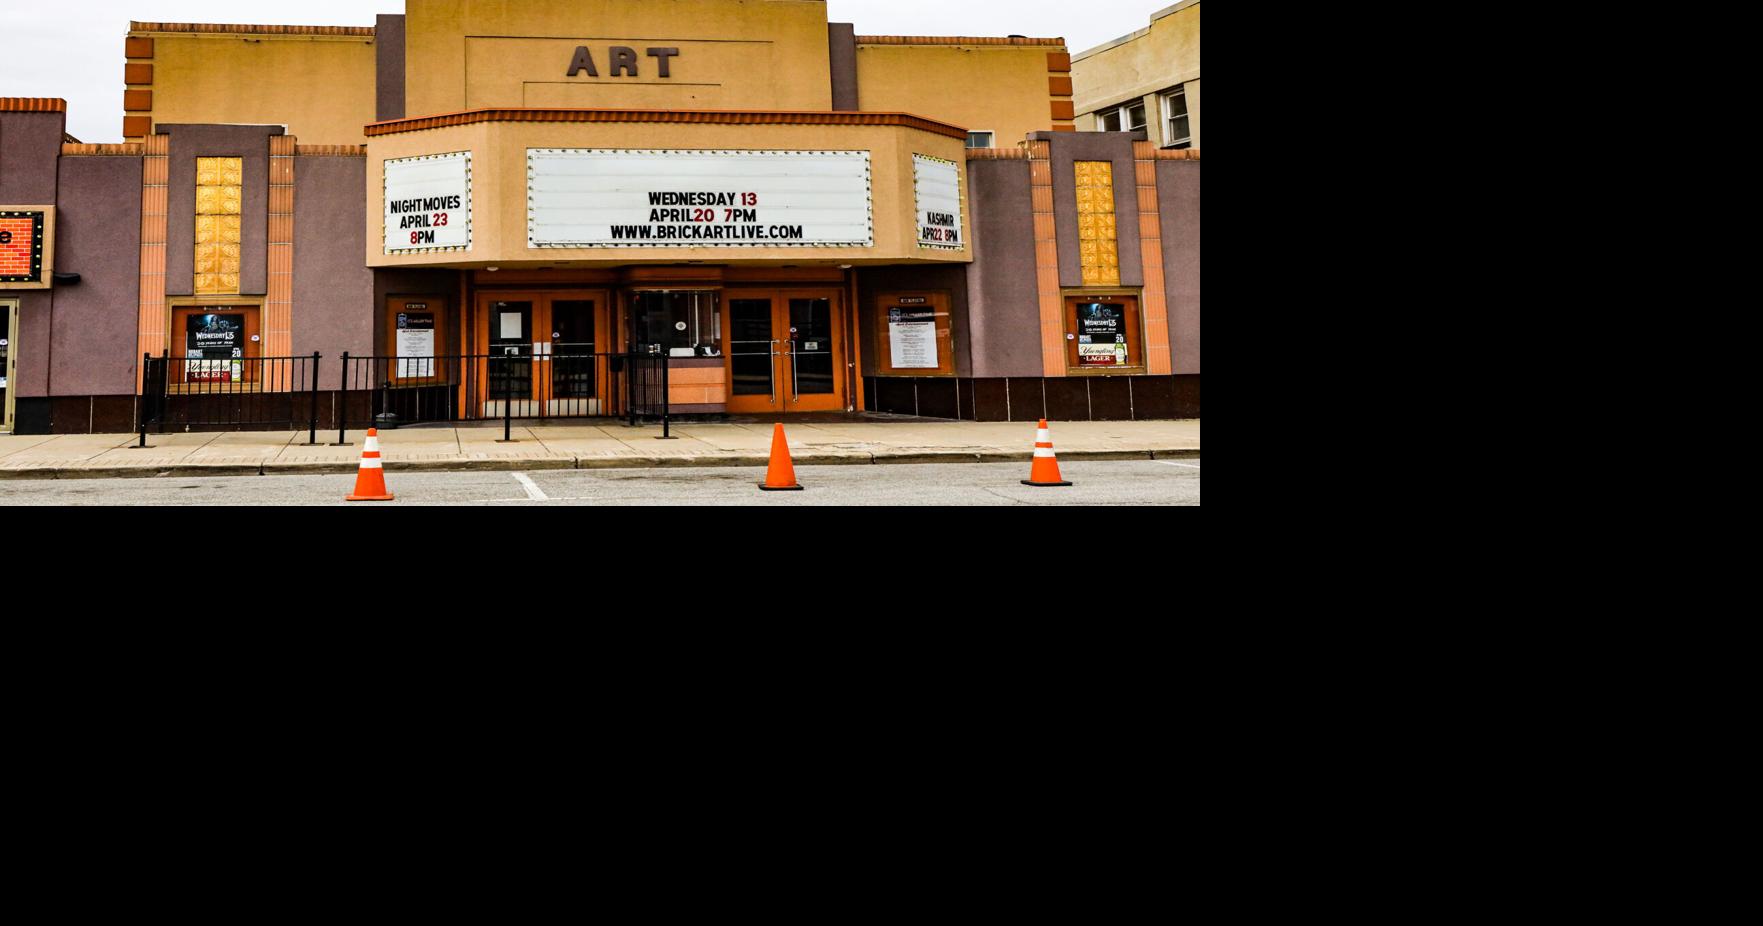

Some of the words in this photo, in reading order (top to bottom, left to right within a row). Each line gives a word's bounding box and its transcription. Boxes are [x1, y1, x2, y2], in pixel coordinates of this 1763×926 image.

[566, 46, 679, 77] ART
[648, 191, 736, 206] WEDNESDAY
[740, 192, 757, 206] 13
[724, 208, 757, 222] 7PM
[927, 211, 955, 227] KASHMIR
[410, 230, 435, 244] 8PM
[610, 225, 803, 239] WWW.BRICKARTLIVE.COM
[944, 228, 958, 242] 8PM
[232, 350, 241, 358] 20
